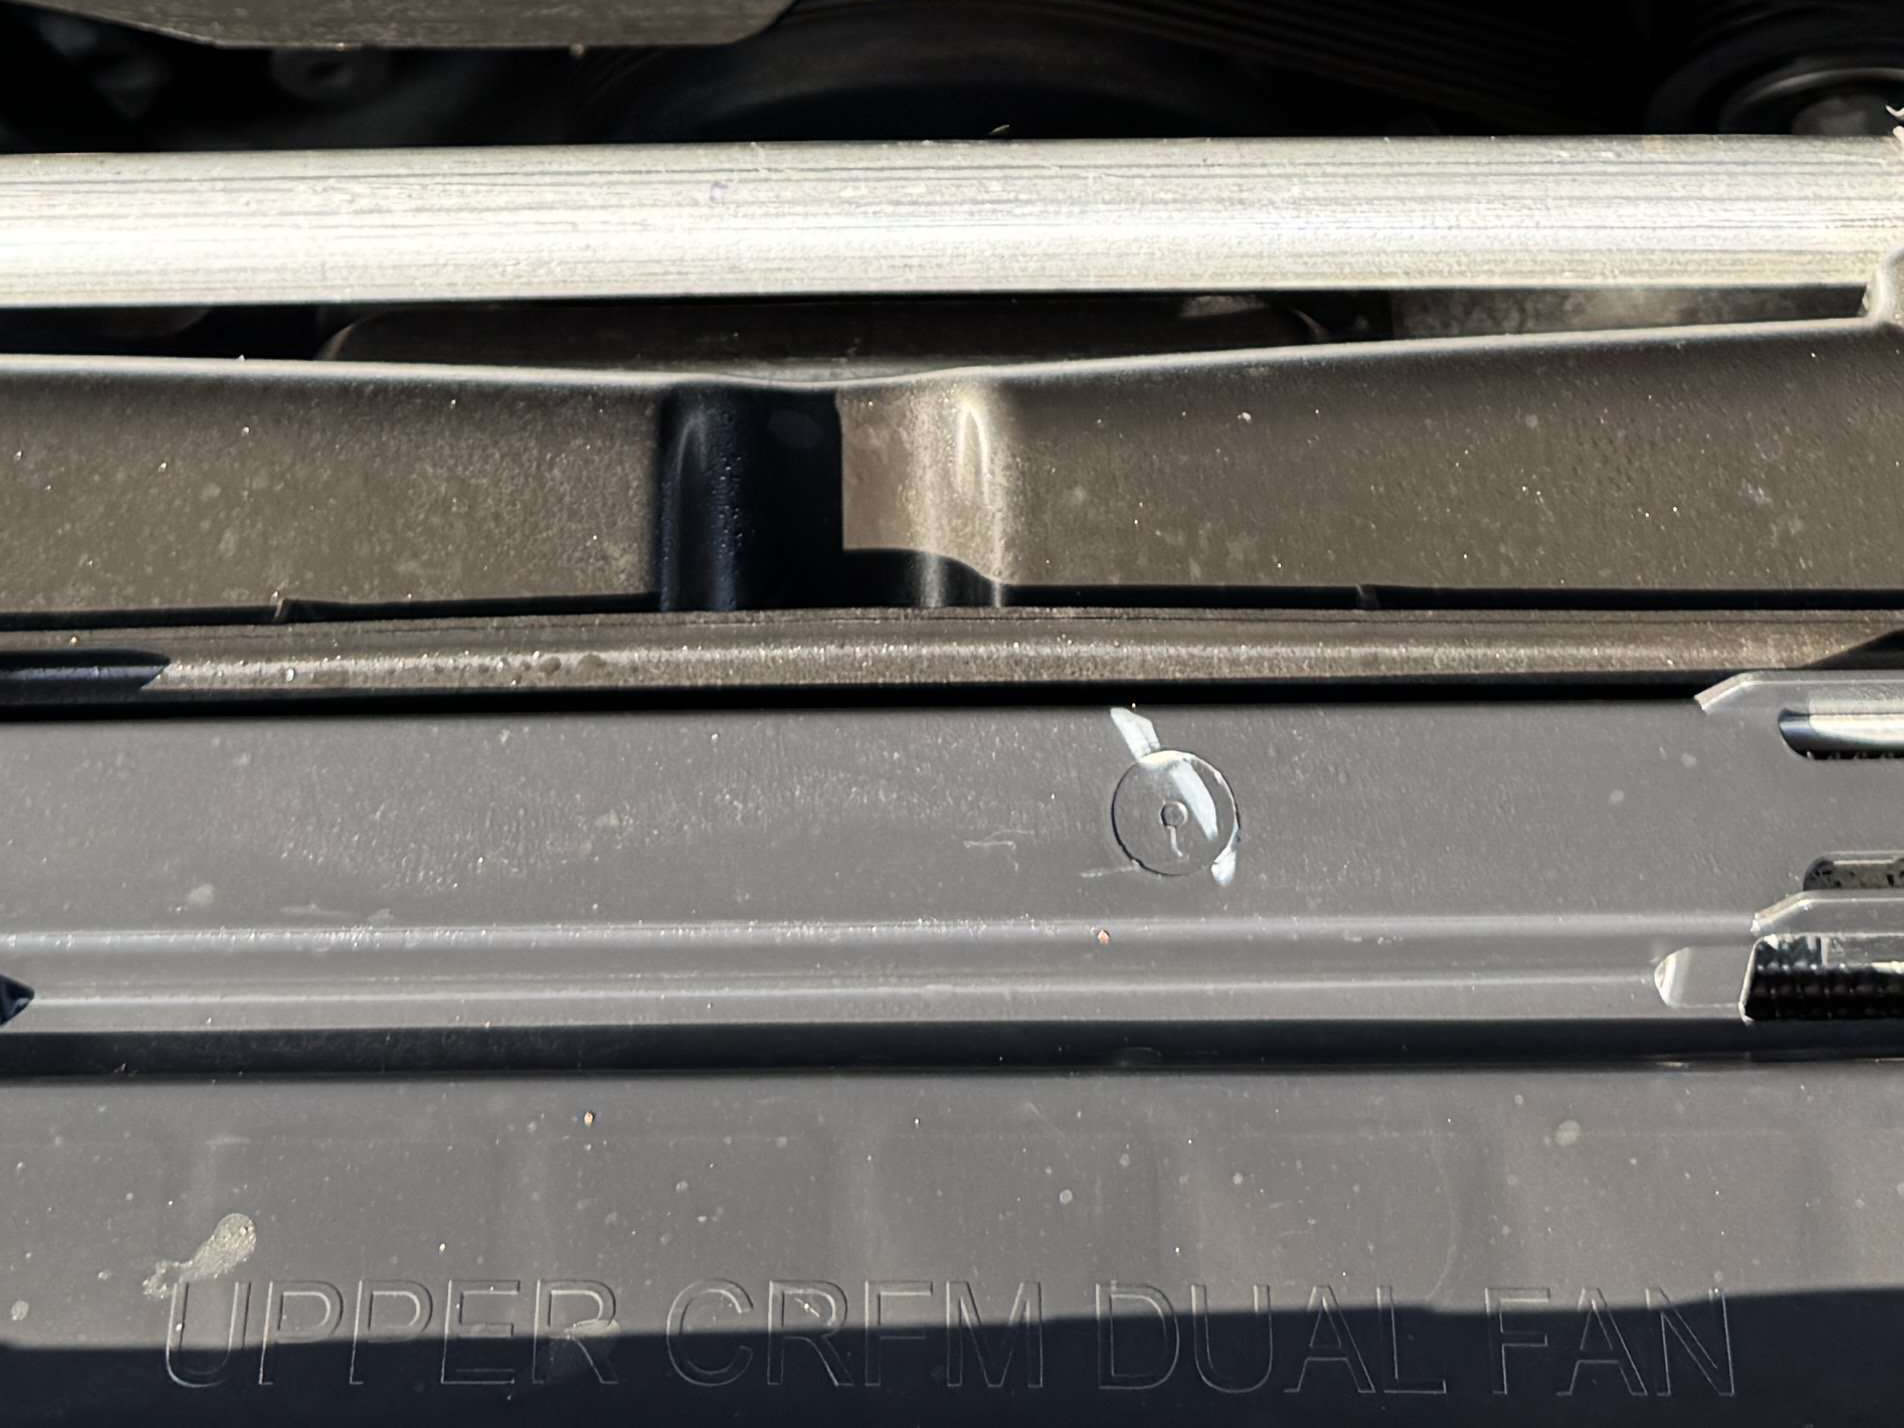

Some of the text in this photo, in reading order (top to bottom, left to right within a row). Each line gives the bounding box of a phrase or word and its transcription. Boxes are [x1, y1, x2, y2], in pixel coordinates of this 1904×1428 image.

[164, 1277, 1736, 1397] UPPER CRFM DUAL FAN
